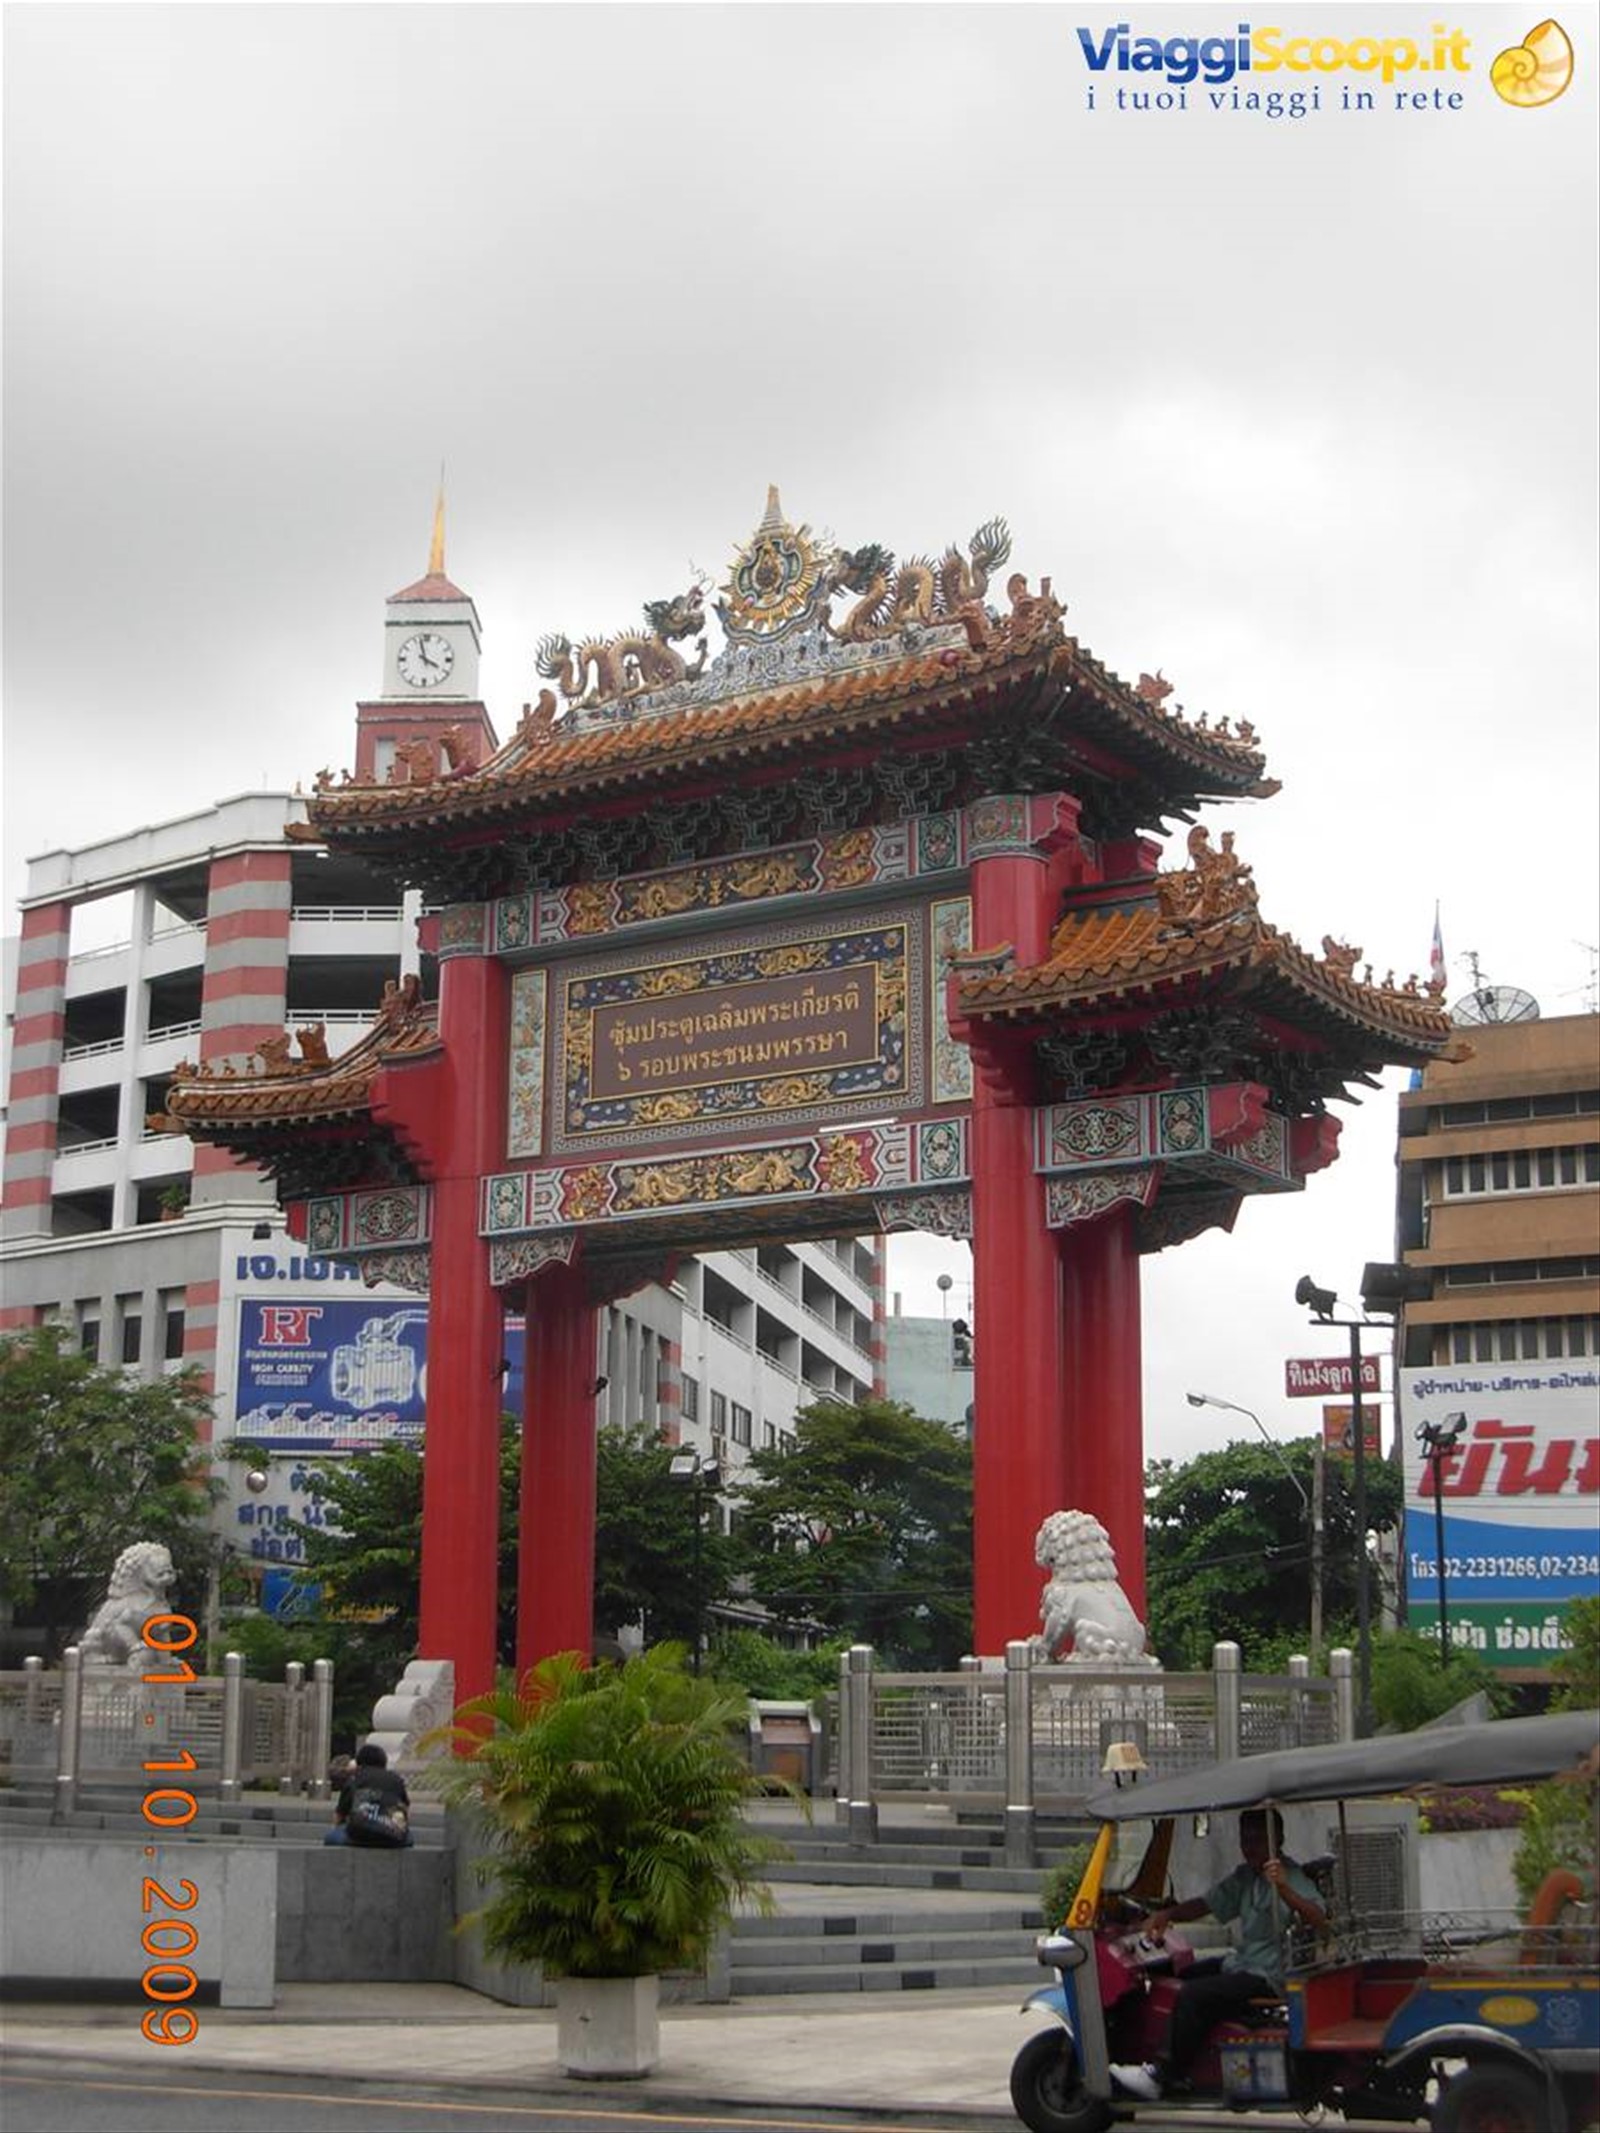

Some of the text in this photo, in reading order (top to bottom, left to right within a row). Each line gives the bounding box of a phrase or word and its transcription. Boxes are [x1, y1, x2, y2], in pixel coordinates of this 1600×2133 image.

[609, 982, 860, 1054] ซุ้มประตูเฉลิมพระเกียรติ
[639, 1028, 848, 1079] รอบพระชนมพรรษา
